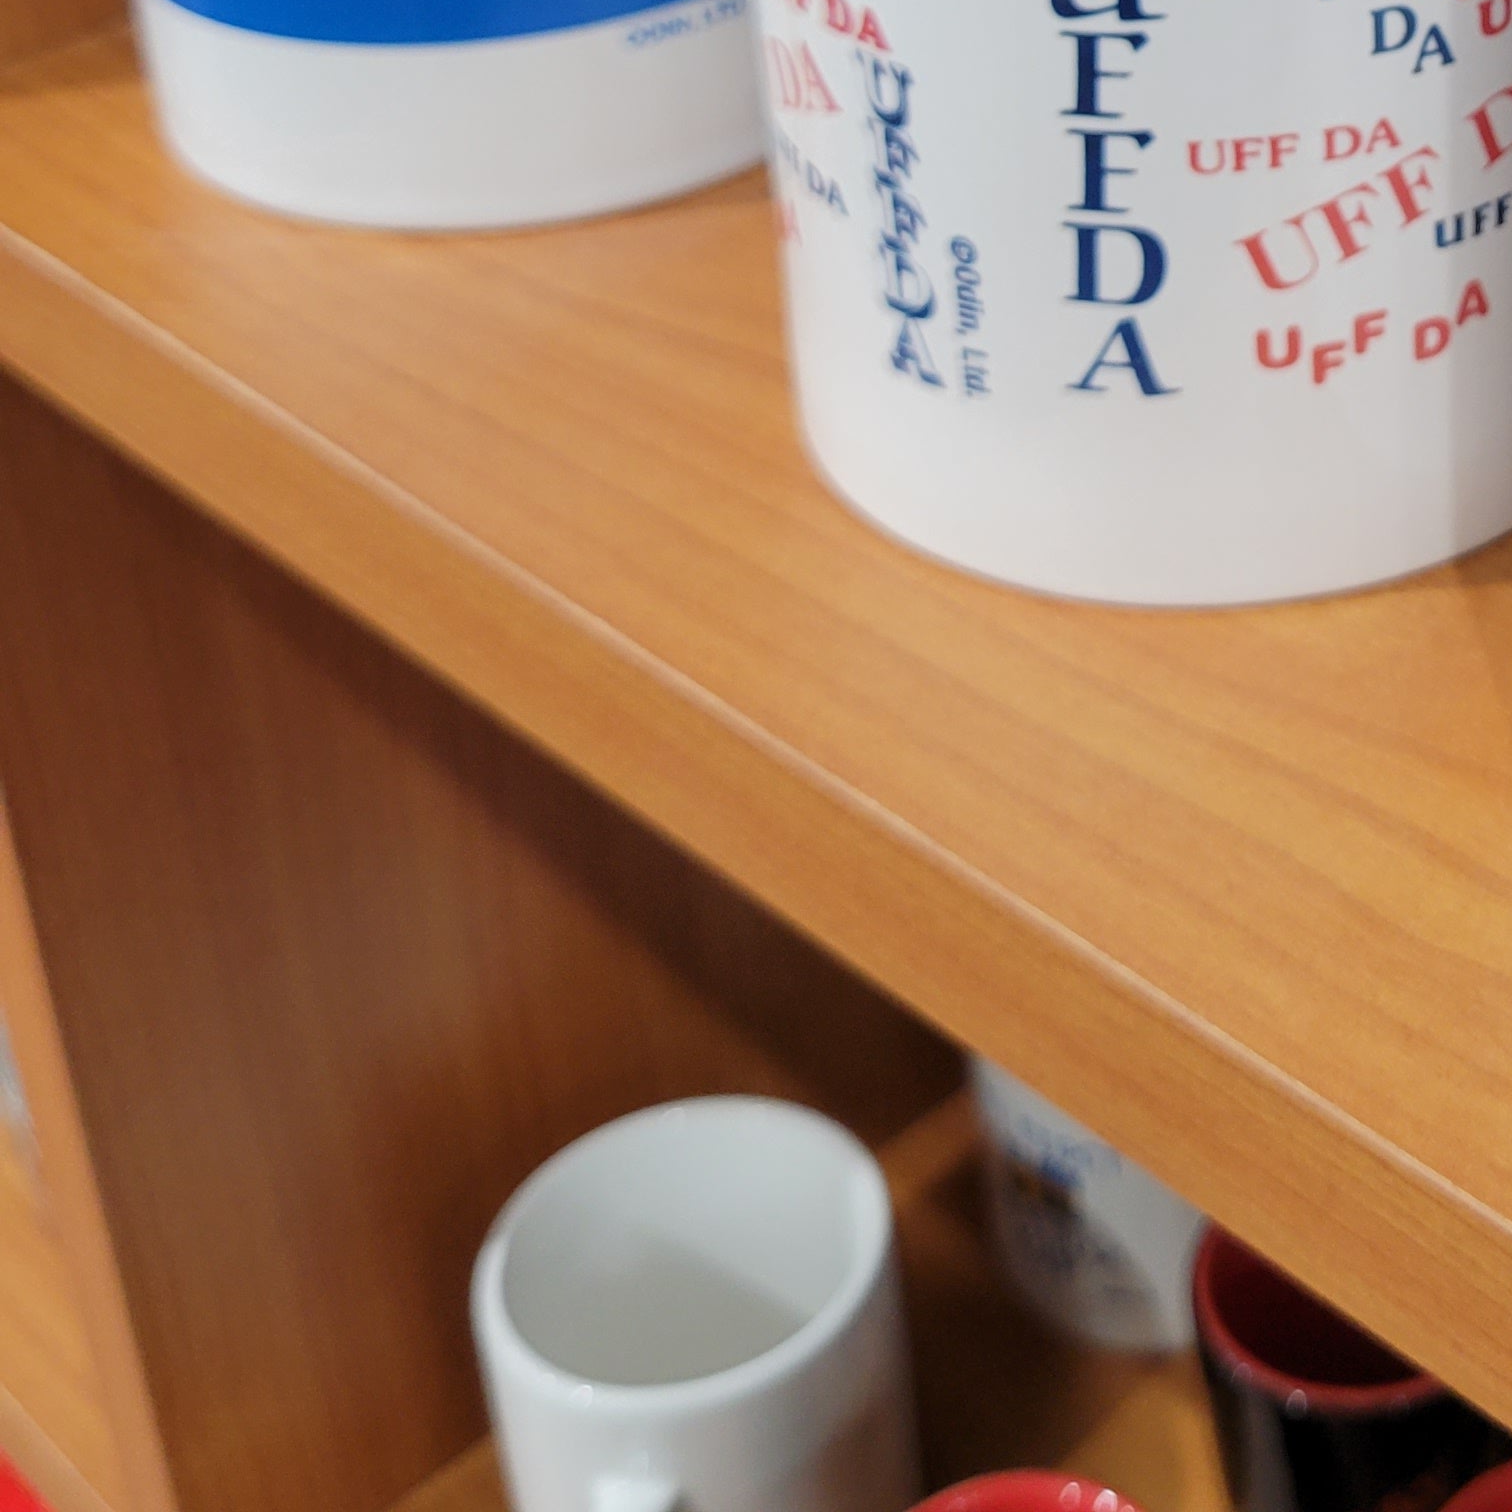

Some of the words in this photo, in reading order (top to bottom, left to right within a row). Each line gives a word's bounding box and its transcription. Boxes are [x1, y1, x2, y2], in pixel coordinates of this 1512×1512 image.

[1370, 5, 1456, 75] DA
[1187, 131, 1299, 176] UFF
[1322, 117, 1403, 162] DA
[1233, 145, 1441, 292] UFF
[1255, 310, 1388, 386] UFF
[1413, 278, 1490, 362] DA
